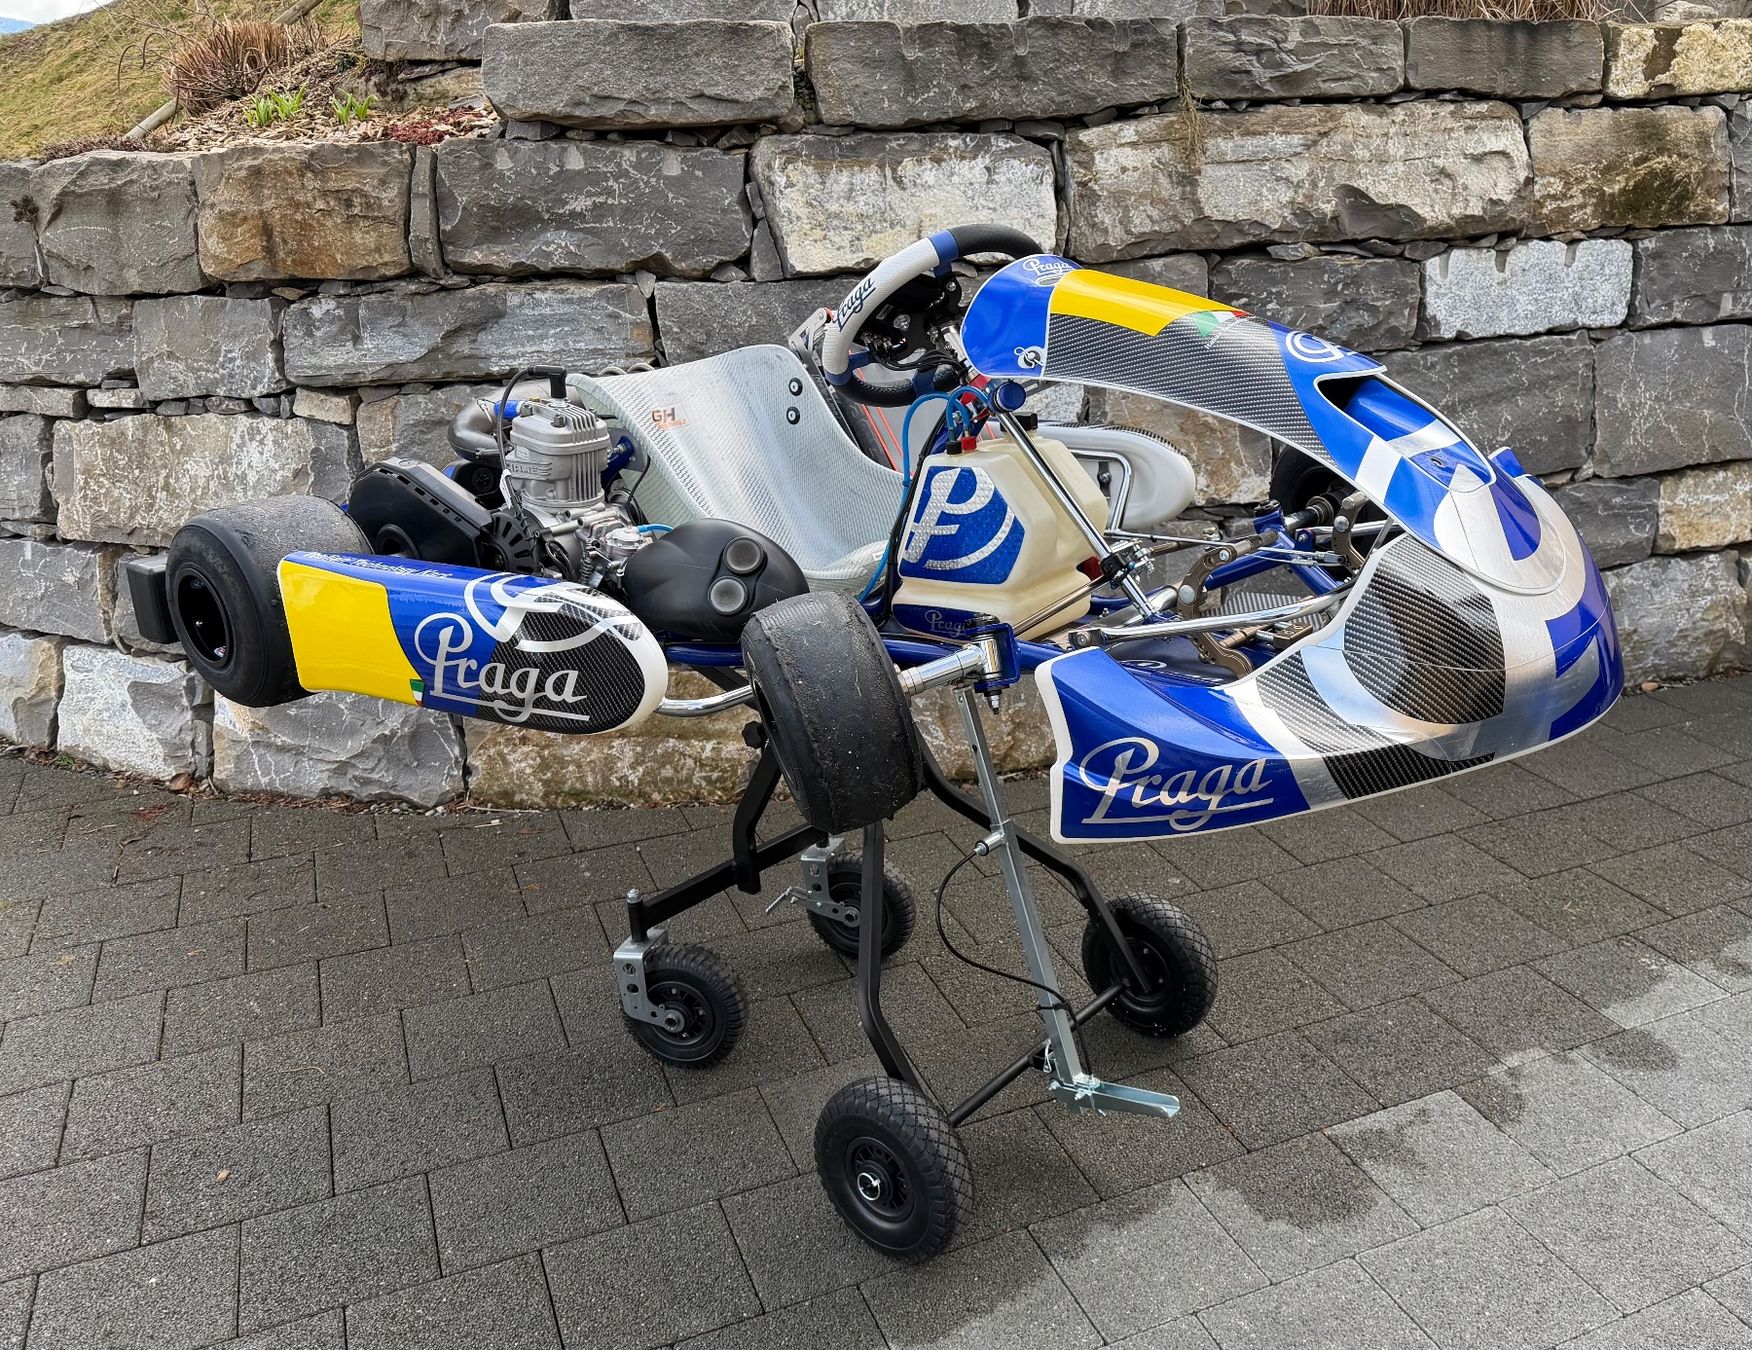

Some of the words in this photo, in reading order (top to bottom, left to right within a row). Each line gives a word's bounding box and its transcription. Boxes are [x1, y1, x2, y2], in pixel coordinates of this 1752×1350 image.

[651, 407, 675, 422] GH
[924, 609, 966, 638] Prag
[414, 612, 590, 723] Praga
[1079, 736, 1274, 831] Praga
